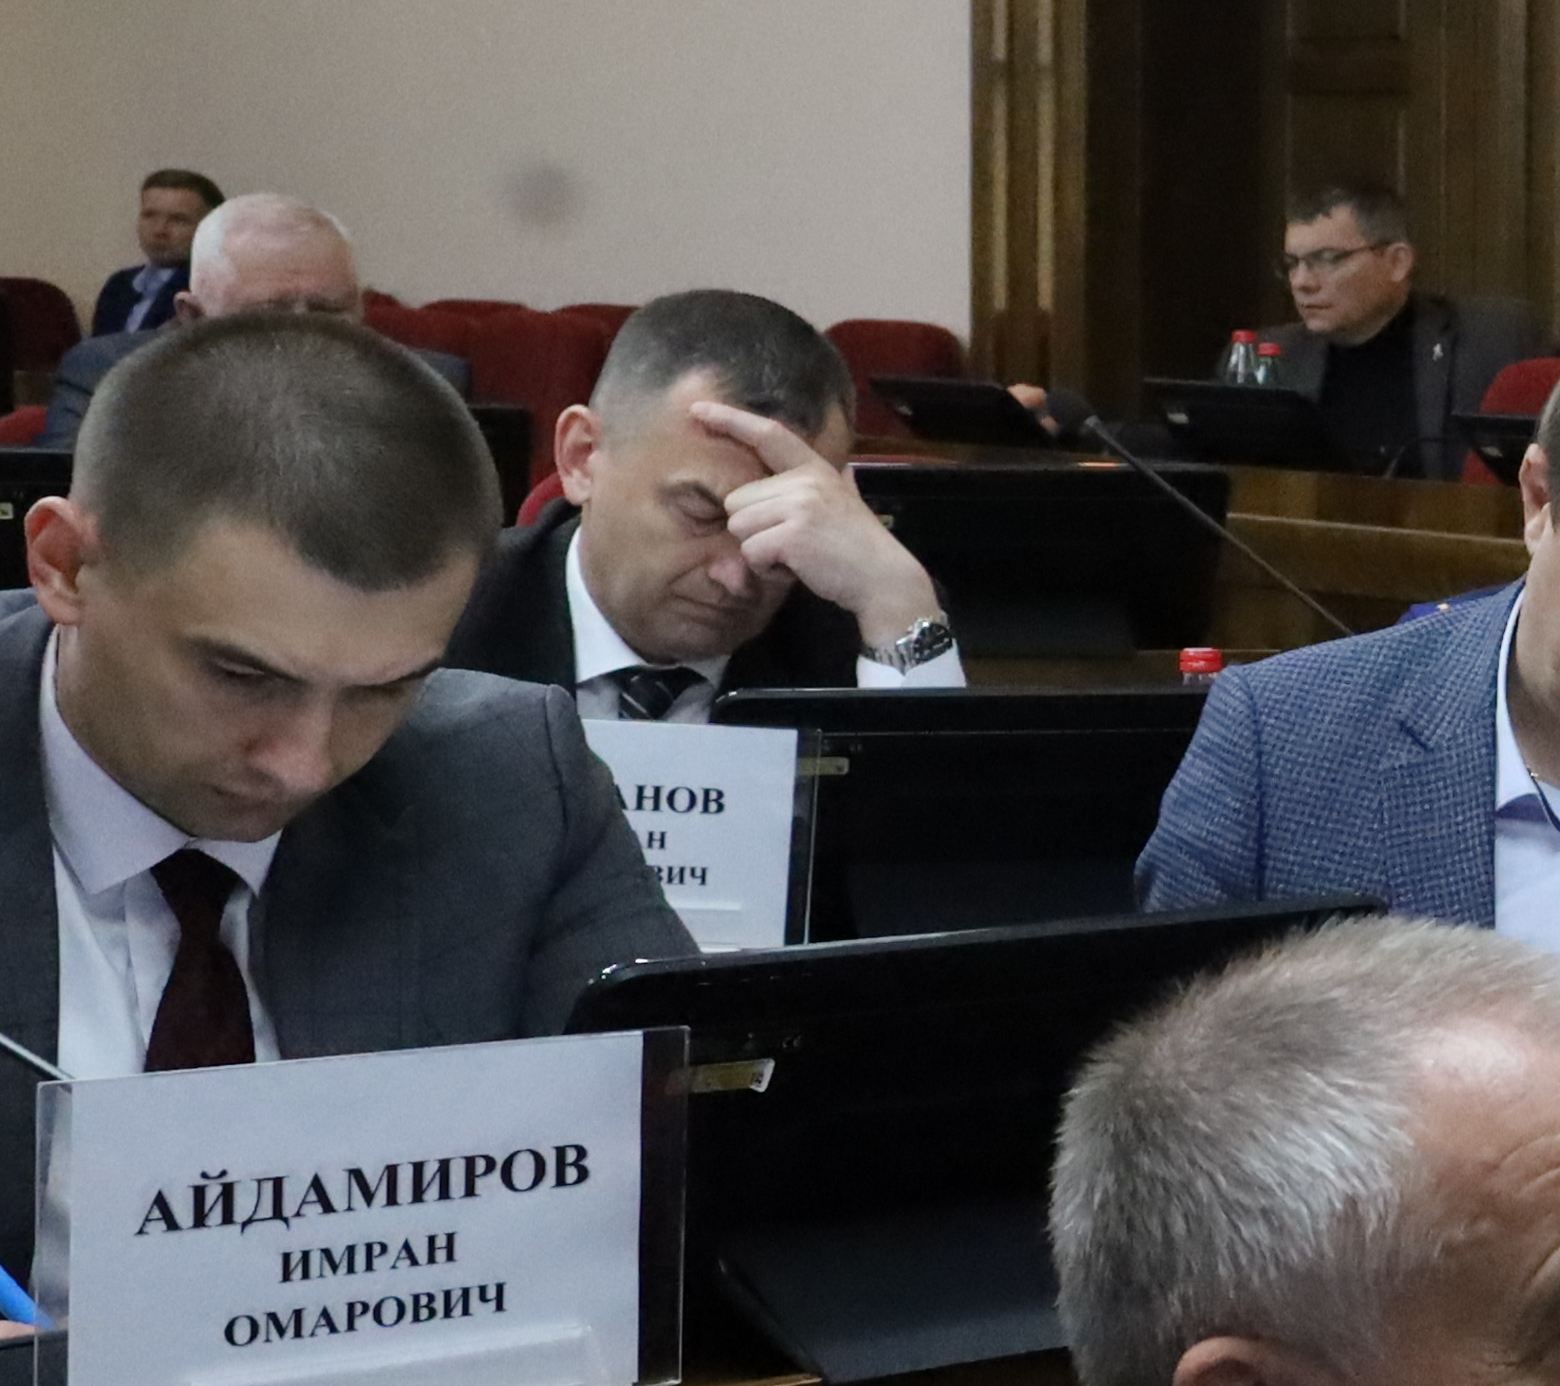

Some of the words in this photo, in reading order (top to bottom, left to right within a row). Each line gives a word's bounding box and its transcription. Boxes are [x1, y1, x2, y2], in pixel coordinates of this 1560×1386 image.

[135, 1144, 589, 1235] АЙДАМИРОВ
[280, 1232, 456, 1283] ИМРАН
[224, 1282, 505, 1346] ОМАРОВИЧ
